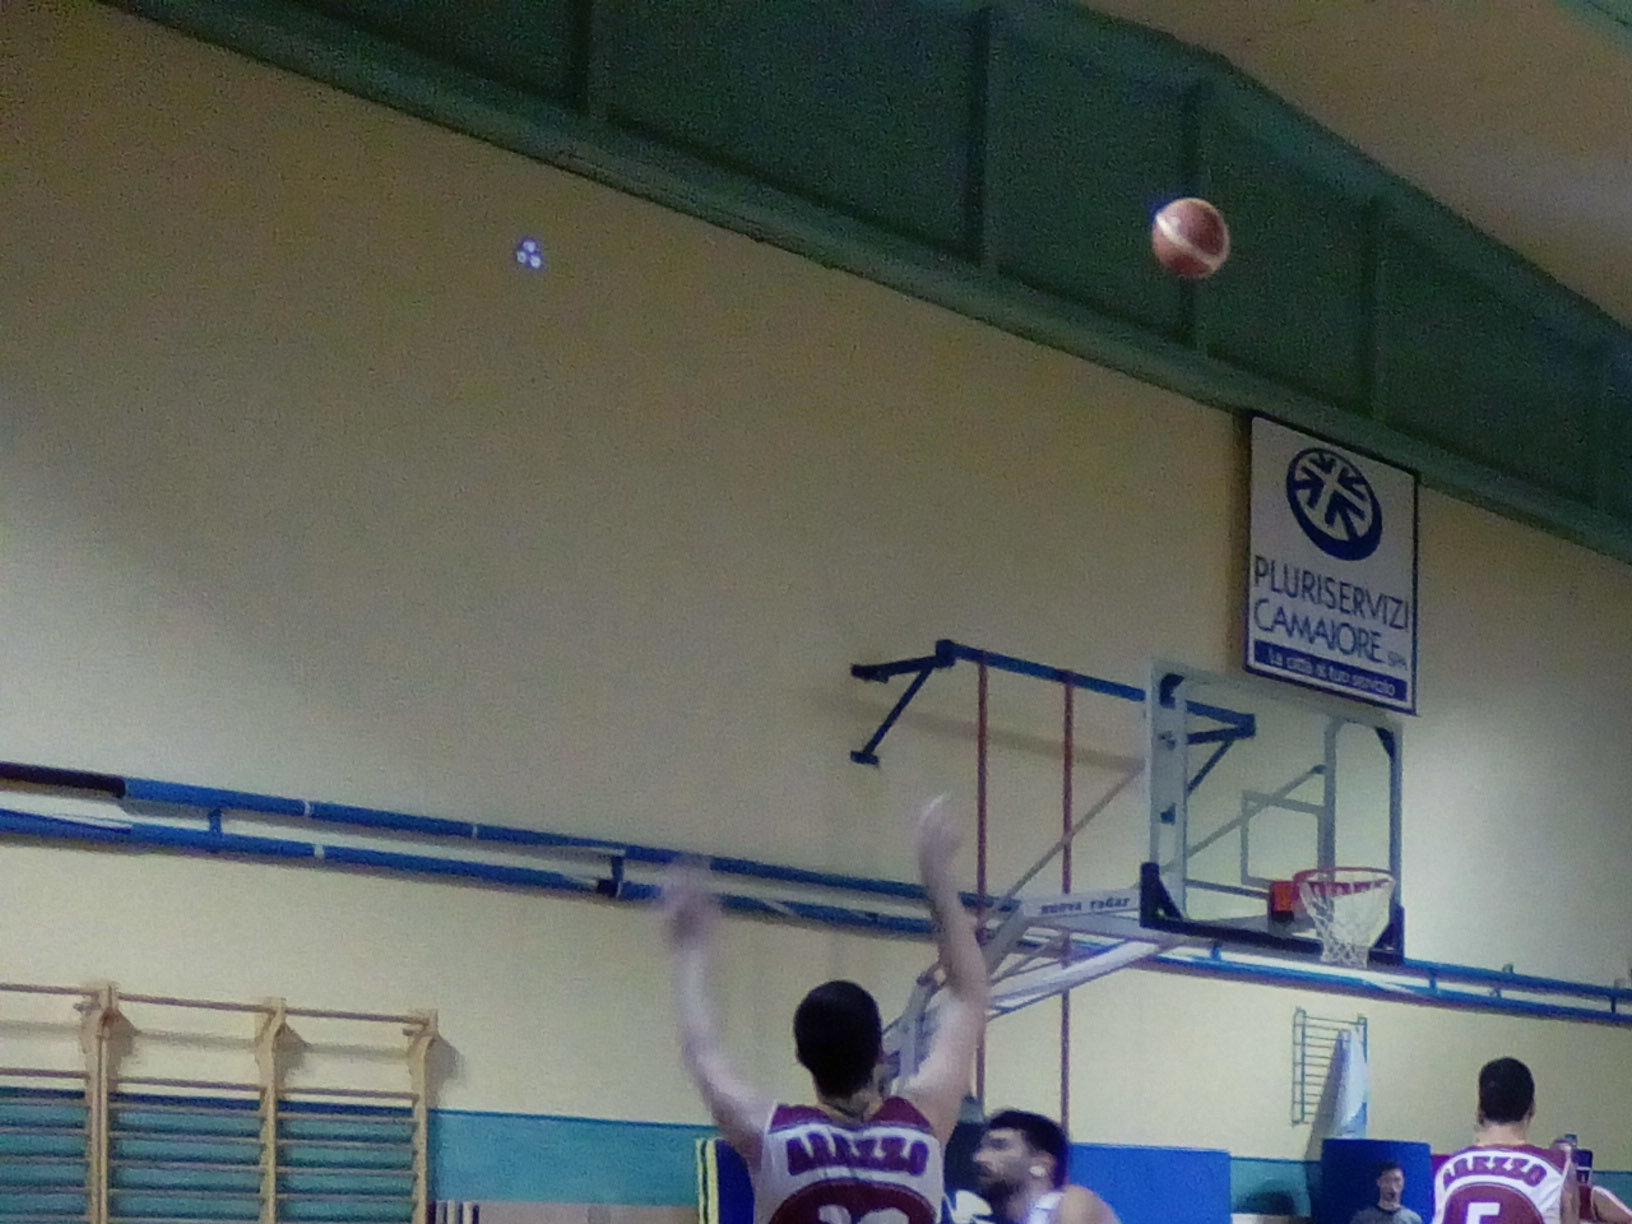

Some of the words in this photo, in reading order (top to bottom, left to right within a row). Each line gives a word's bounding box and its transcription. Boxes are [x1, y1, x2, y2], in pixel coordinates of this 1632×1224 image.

[1254, 554, 1409, 632] PLURISERVIZI
[1253, 599, 1388, 664] CAMAIORE
[786, 1131, 930, 1177] AREZZO
[1443, 1155, 1548, 1192] AREZZO
